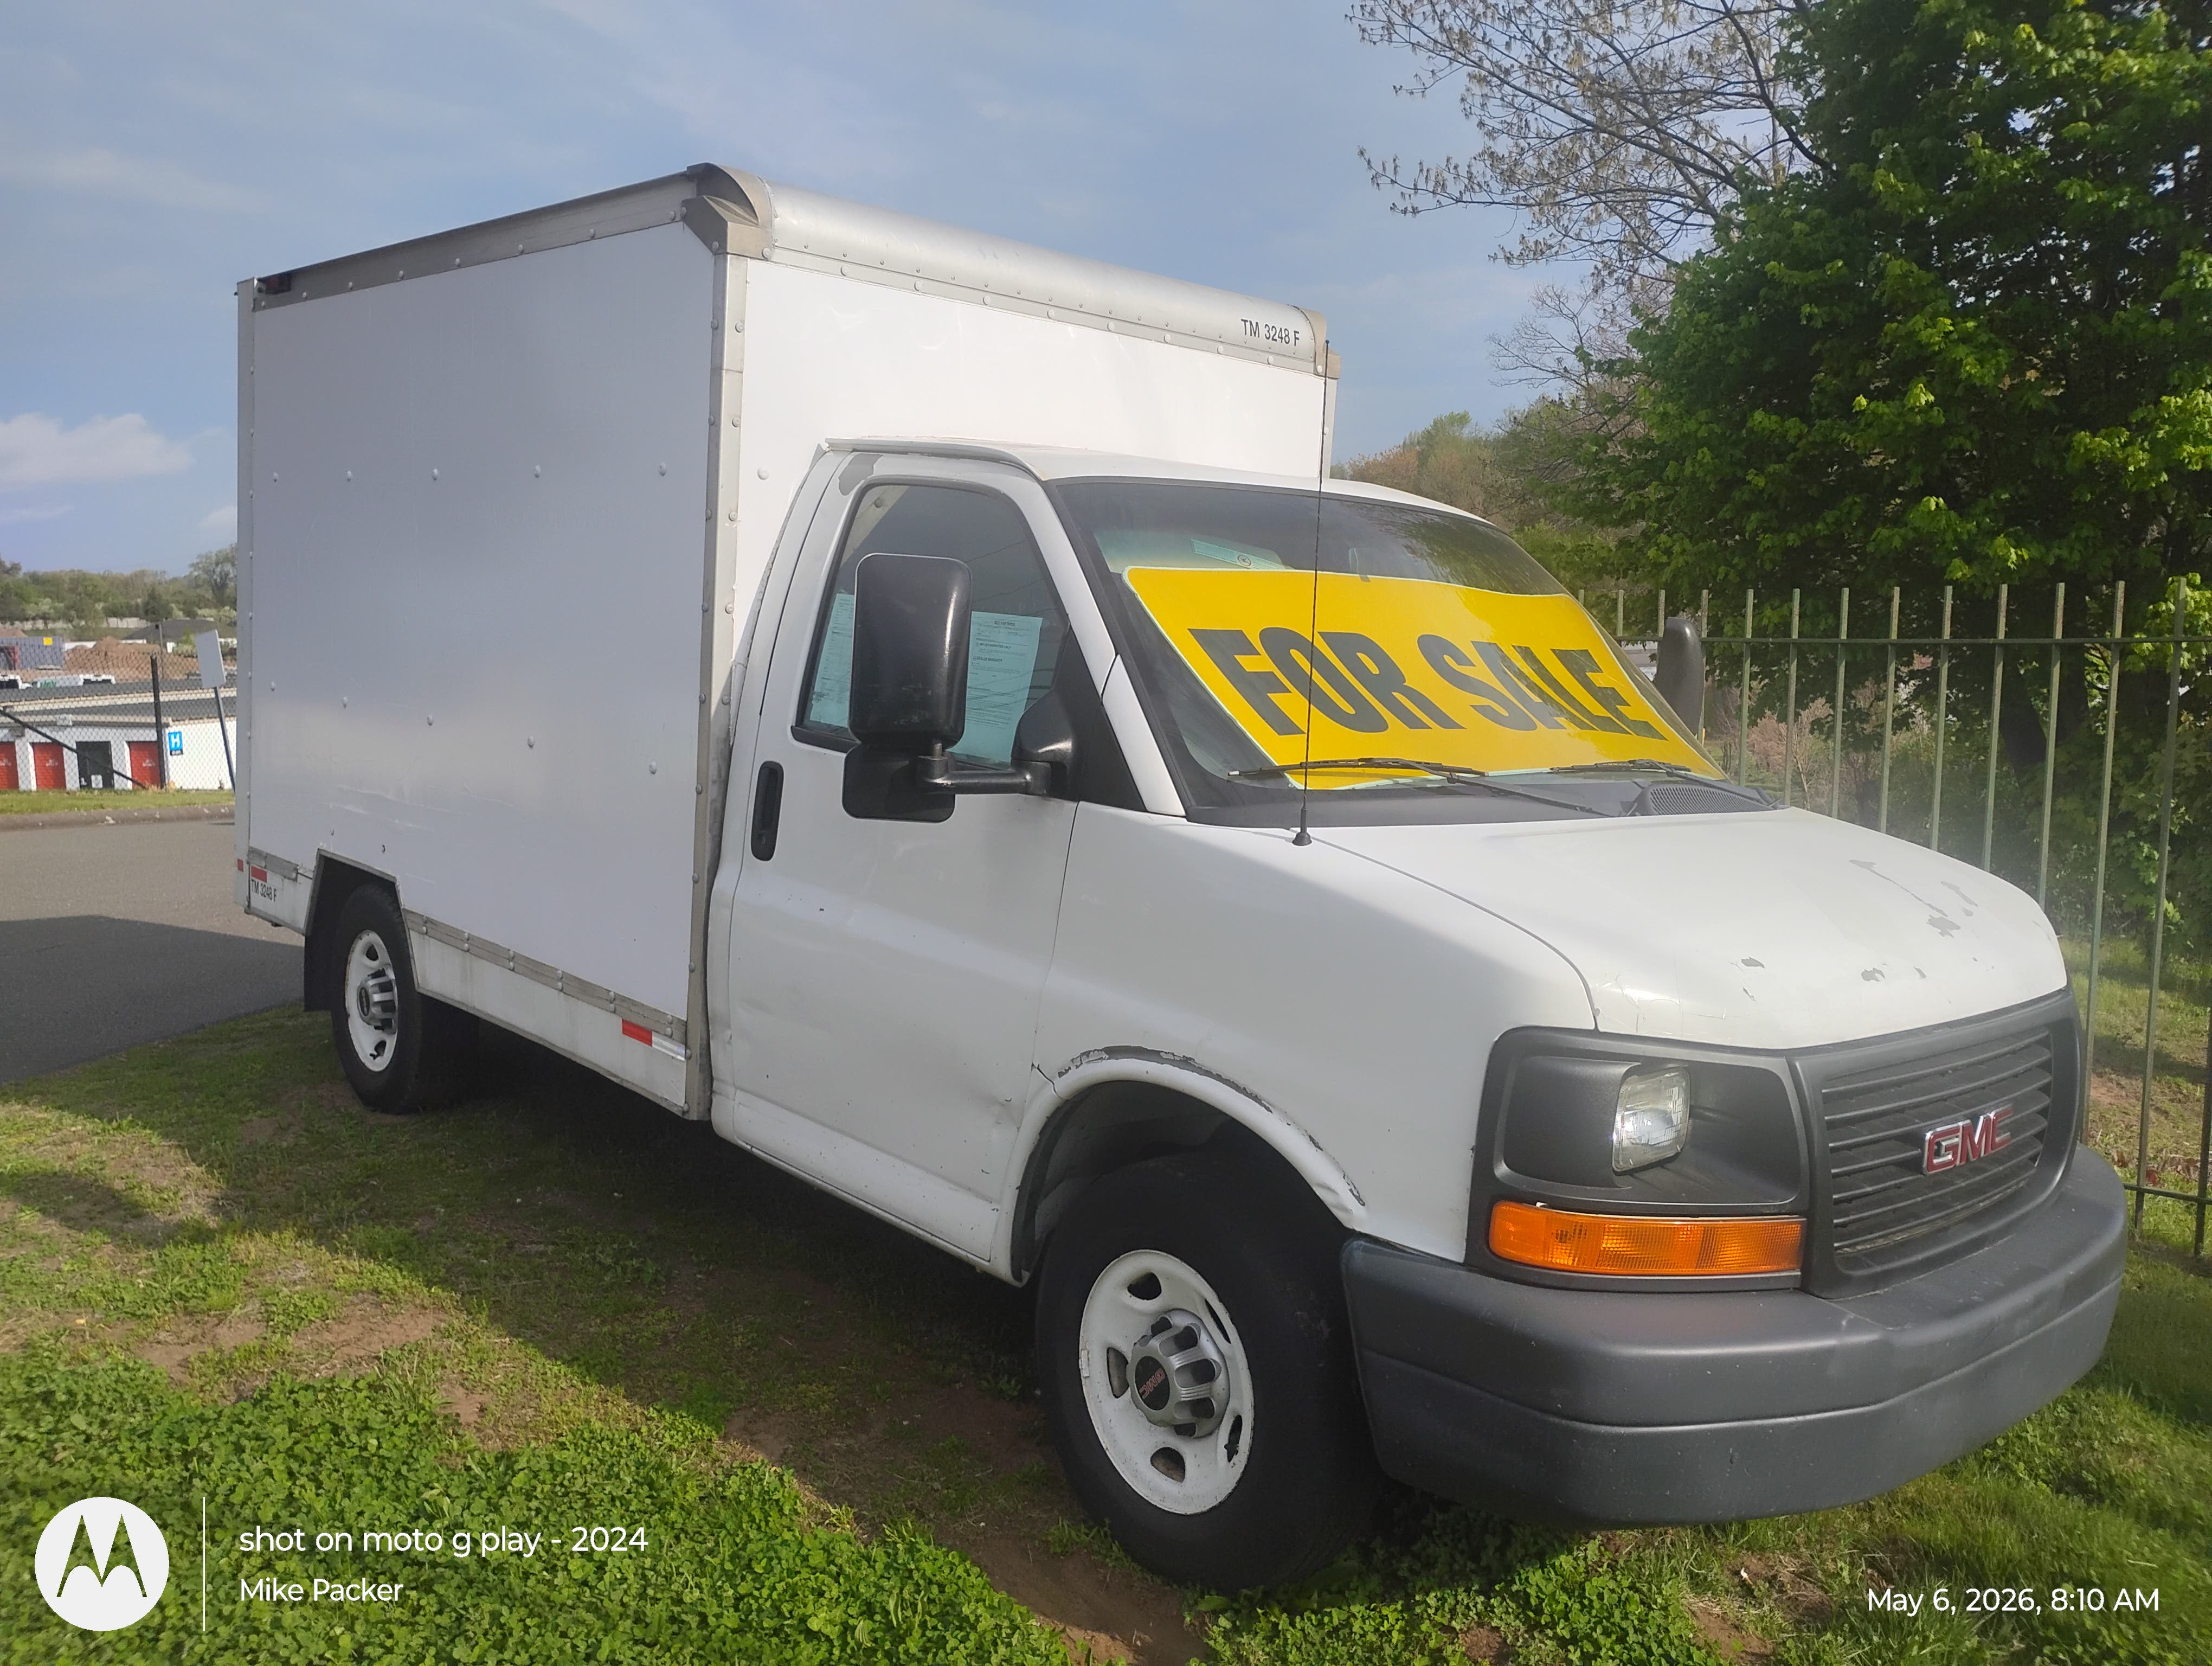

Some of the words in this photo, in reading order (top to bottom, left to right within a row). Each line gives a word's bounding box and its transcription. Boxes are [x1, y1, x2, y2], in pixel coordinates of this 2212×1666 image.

[1240, 318, 1260, 338] TM
[1264, 323, 1290, 344] 3248
[1293, 330, 1300, 347] F
[1188, 627, 1468, 736] FOR
[1417, 634, 1669, 741] SALE
[171, 733, 180, 748] H
[251, 879, 259, 894] TM
[260, 883, 272, 900] 3248
[273, 888, 277, 902] F
[1923, 1102, 2013, 1176] GMC
[1139, 1368, 1165, 1400] GMC
